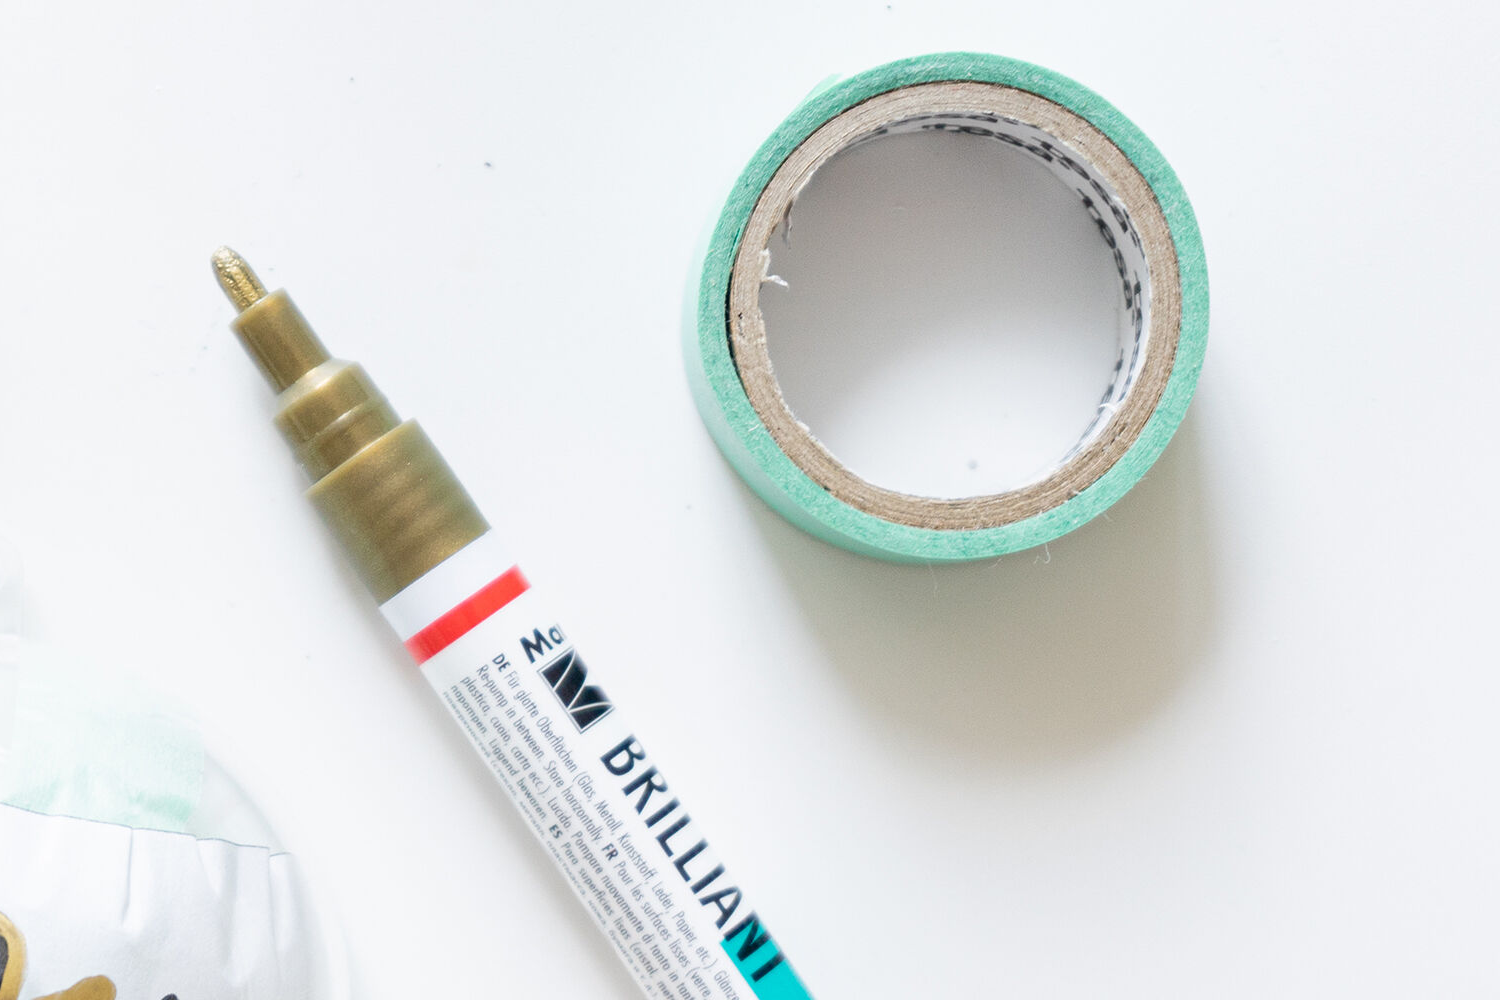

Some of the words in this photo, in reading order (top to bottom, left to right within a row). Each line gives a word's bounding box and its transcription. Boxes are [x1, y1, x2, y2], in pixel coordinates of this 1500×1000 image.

[476, 663, 509, 708] Re-pump
[504, 705, 517, 720] in
[542, 760, 565, 788] Store
[600, 842, 619, 862] FR
[613, 860, 634, 886] Pour
[629, 883, 645, 902] les
[640, 901, 672, 941] surfaces
[668, 938, 691, 968] lisses
[491, 652, 512, 673] DE
[503, 670, 520, 690] Für
[513, 690, 539, 718] glatte
[535, 716, 578, 773] Oberflächen
[600, 734, 786, 983] BRILLIANT
